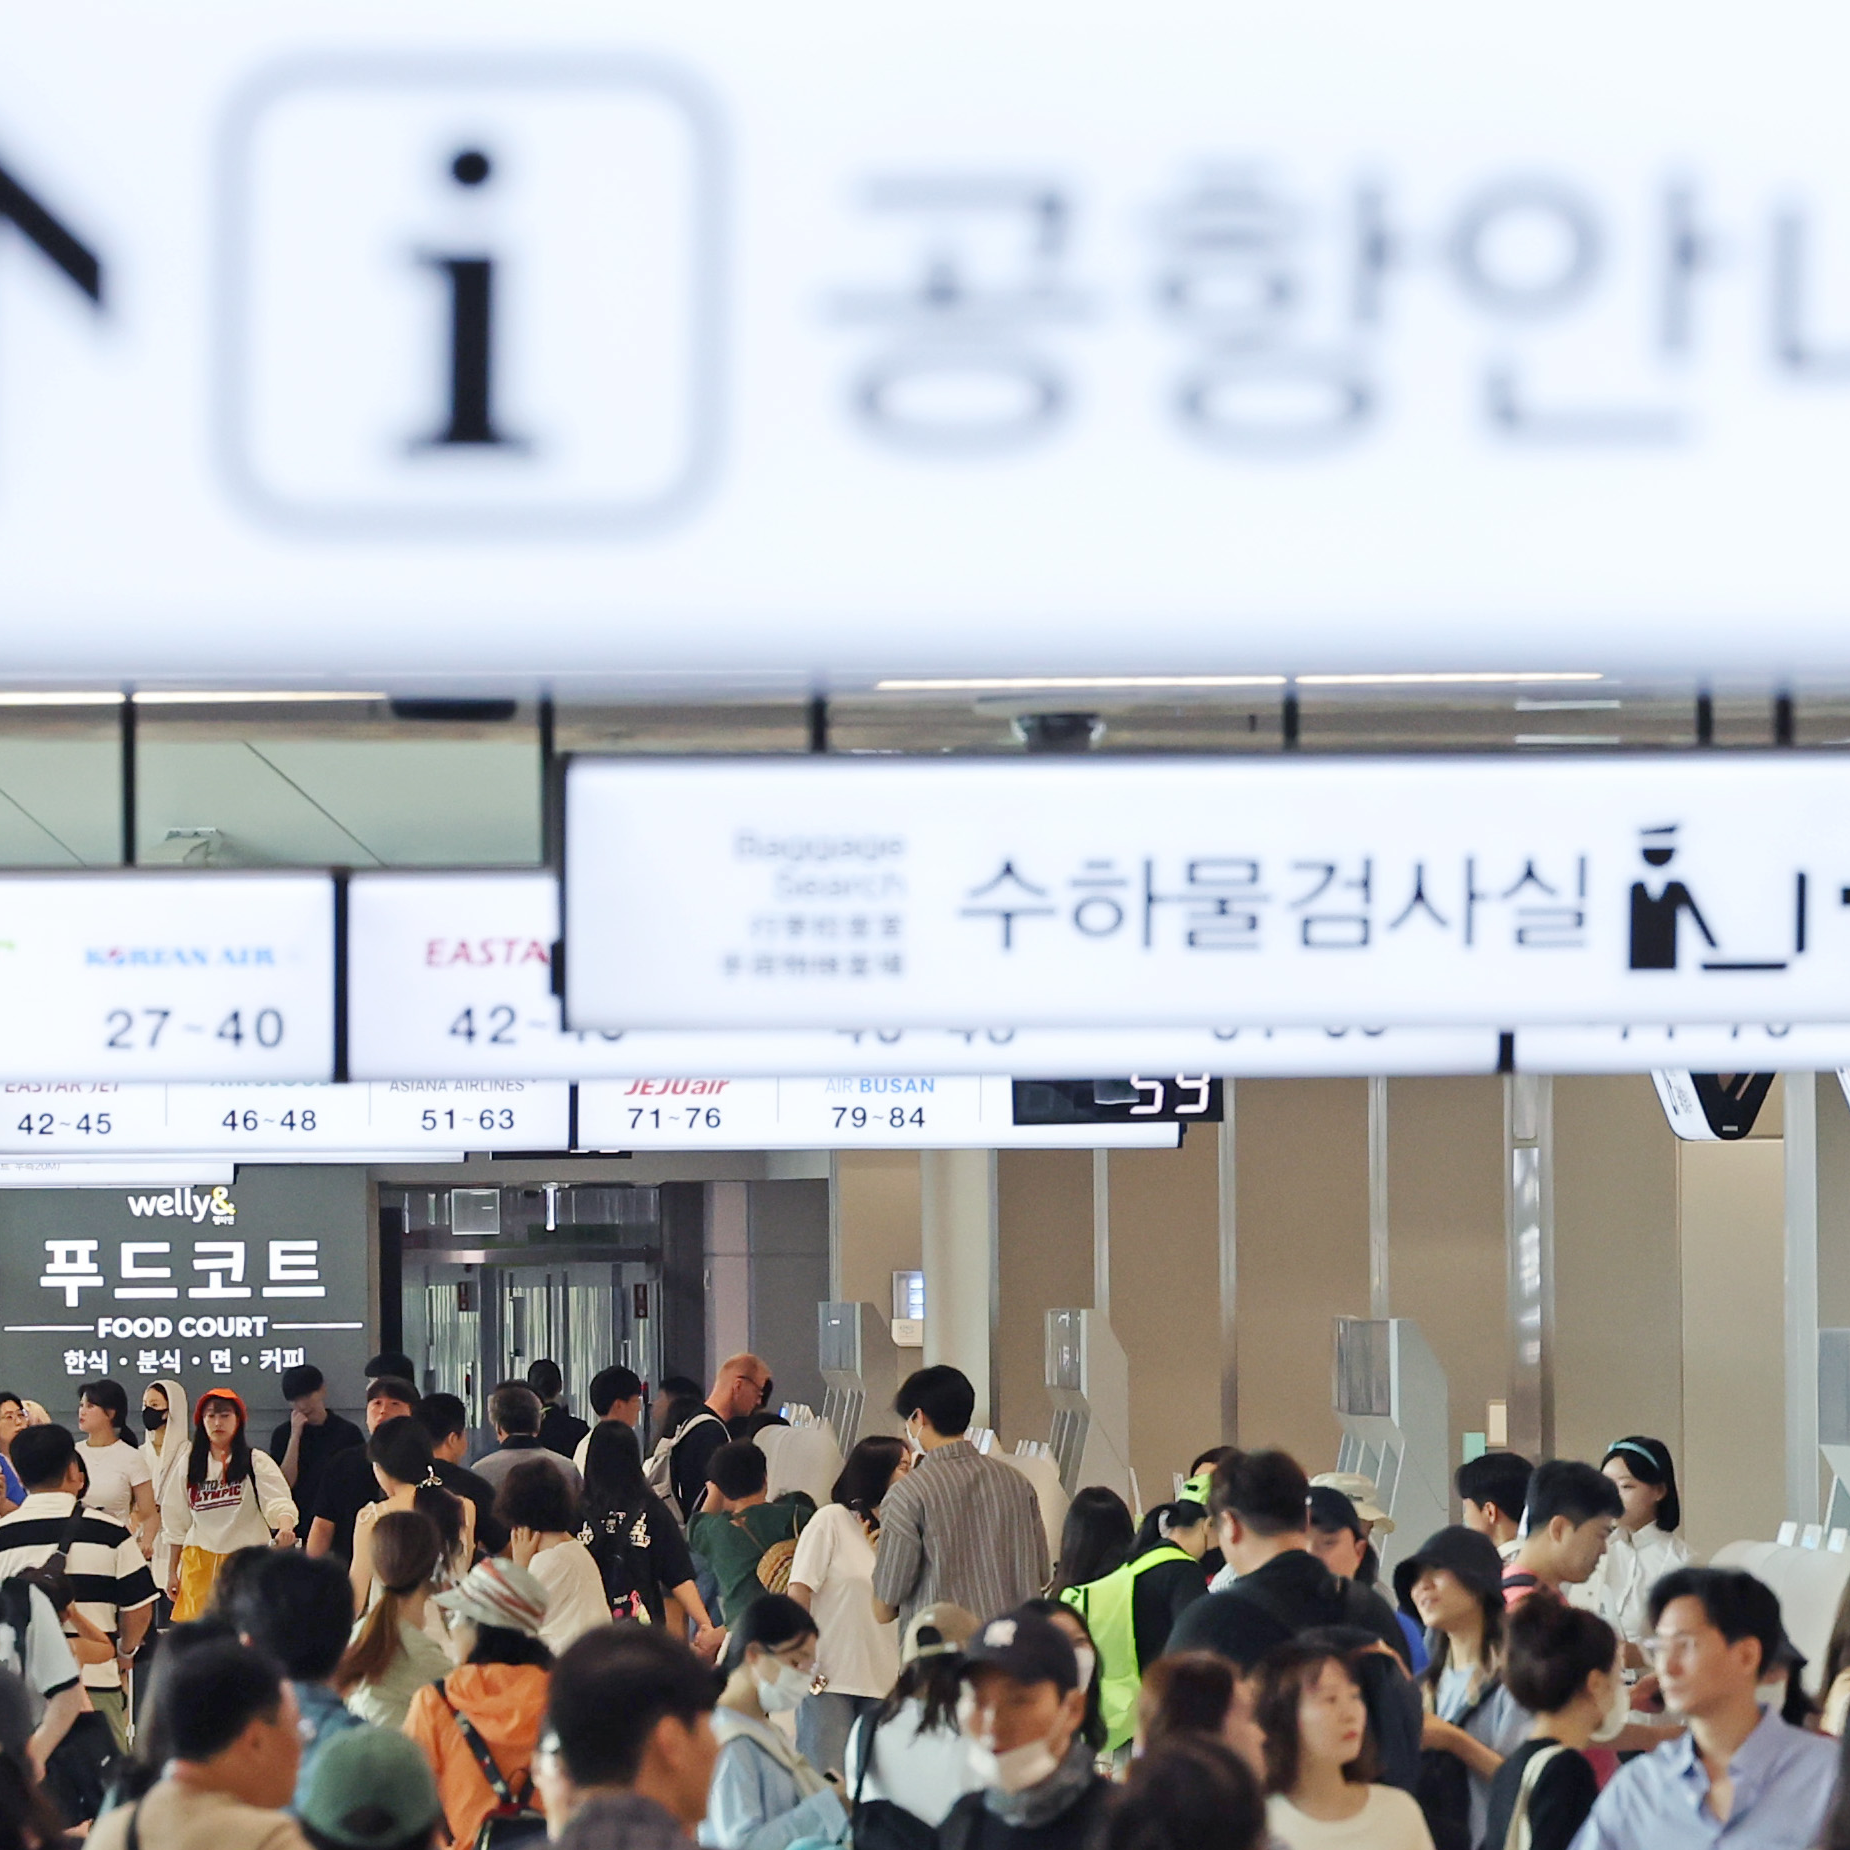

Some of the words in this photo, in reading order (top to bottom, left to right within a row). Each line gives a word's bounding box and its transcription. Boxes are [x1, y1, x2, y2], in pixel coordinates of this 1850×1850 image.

[958, 856, 1591, 952] 수하물검사실
[84, 947, 208, 968] KOREAN
[222, 947, 276, 967] AIR
[425, 937, 552, 967] EASTA
[390, 1079, 448, 1093] ASIANA
[454, 1079, 525, 1093] AIRLINES
[825, 1077, 853, 1094] AIR
[858, 1077, 935, 1094] BUSAN
[128, 1186, 236, 1223] welly&
[39, 1239, 327, 1308] 푸드코트
[97, 1317, 173, 1338] FOOD
[178, 1316, 268, 1337] COURT
[64, 1349, 108, 1375] 한식
[136, 1348, 182, 1375] 분식
[210, 1348, 232, 1374] 면
[259, 1347, 305, 1371] 커피
[193, 1485, 242, 1503] LYMPIC
